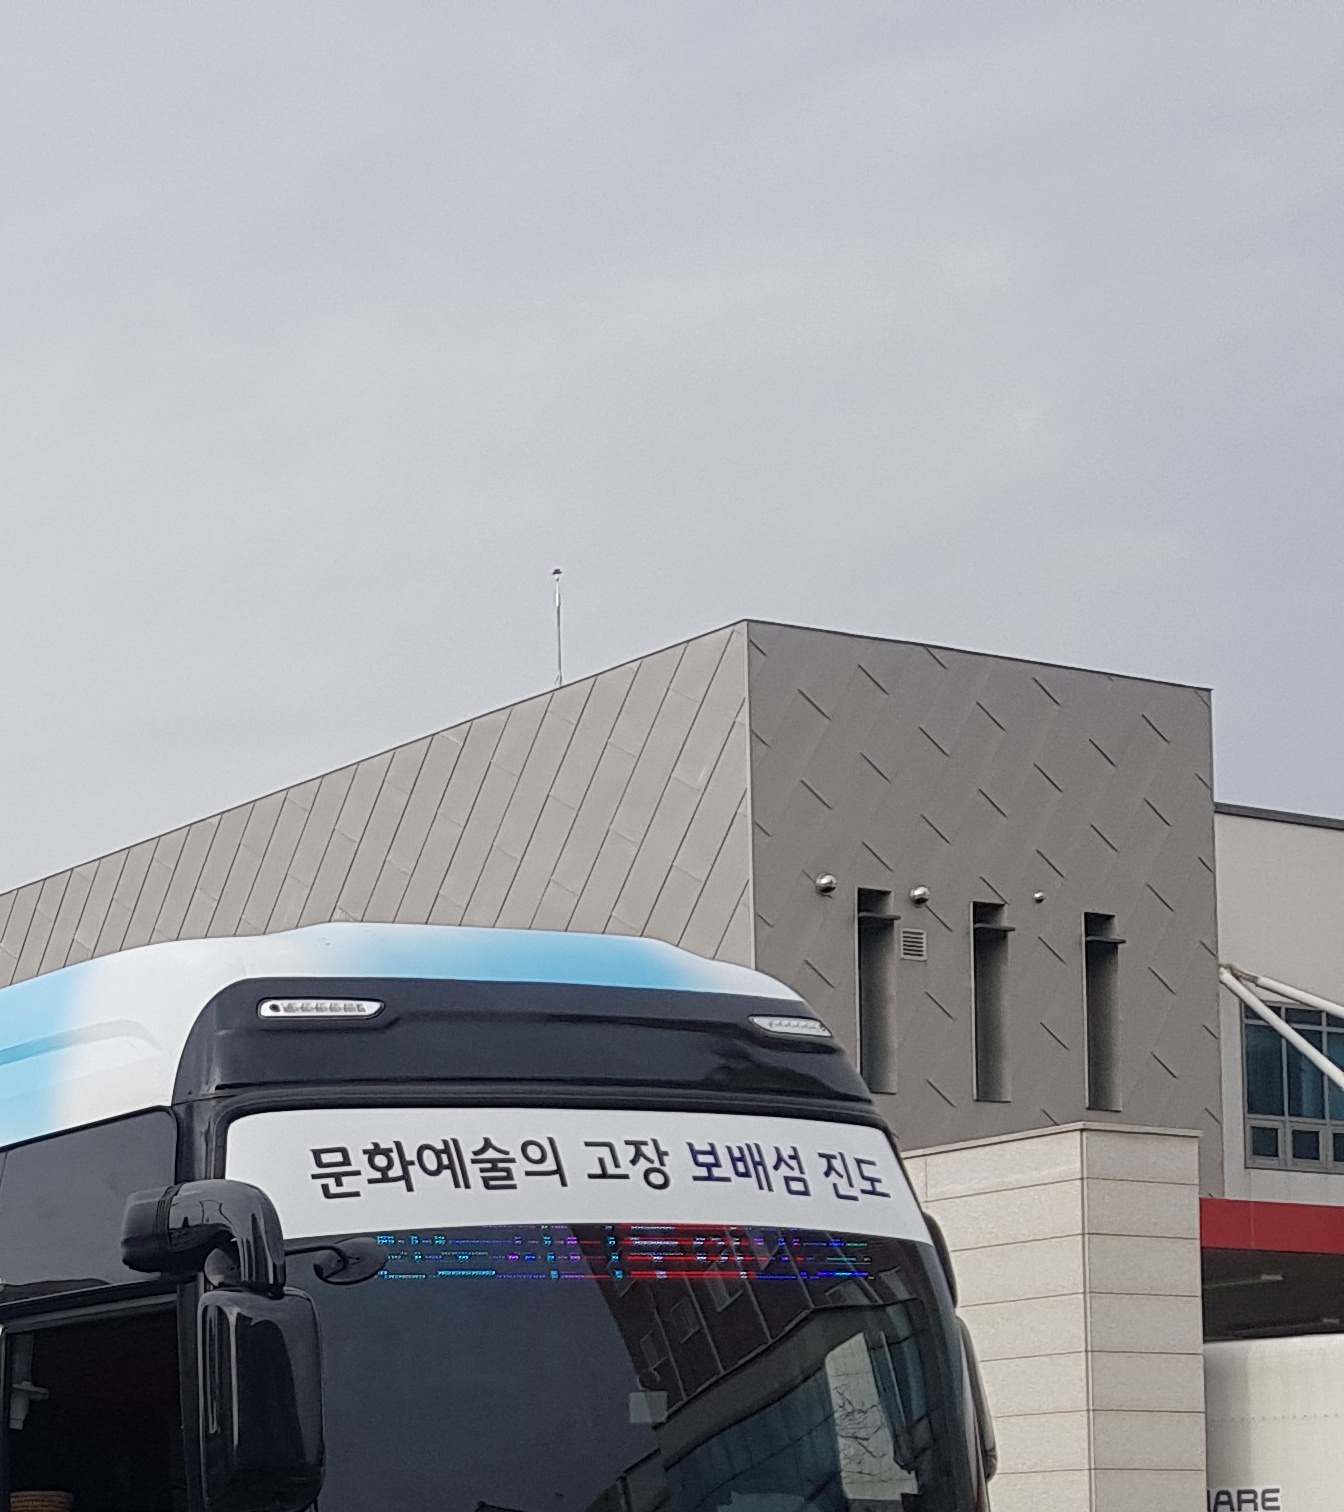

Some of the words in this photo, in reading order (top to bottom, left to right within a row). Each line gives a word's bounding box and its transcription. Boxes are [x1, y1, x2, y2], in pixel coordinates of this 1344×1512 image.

[308, 1135, 570, 1200] 문화예술의
[586, 1137, 671, 1191] 고장
[686, 1138, 812, 1197] 보배섬
[821, 1150, 891, 1203] 진도
